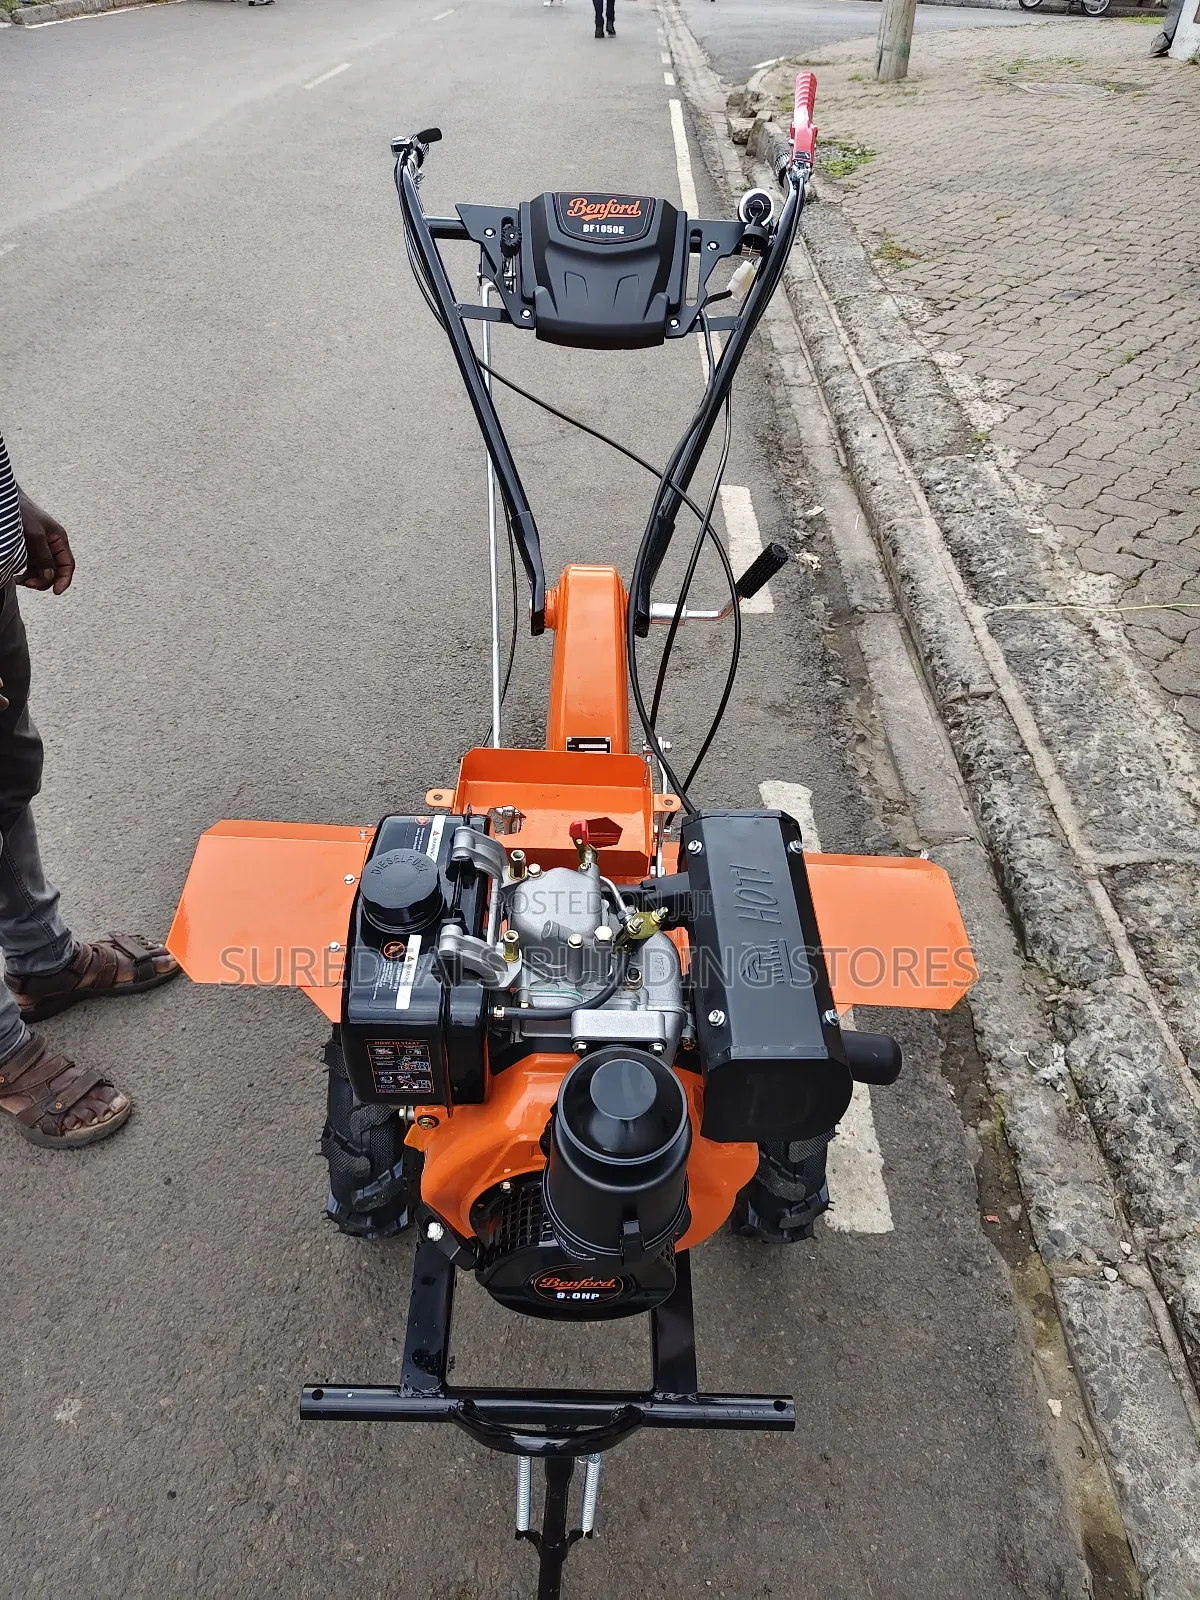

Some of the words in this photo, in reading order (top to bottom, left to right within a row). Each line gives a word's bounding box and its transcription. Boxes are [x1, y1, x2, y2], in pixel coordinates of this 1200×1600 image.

[567, 197, 642, 221] Benford
[583, 224, 625, 235] BF1050E
[729, 863, 782, 925] HOT!
[539, 1277, 616, 1290] Benford
